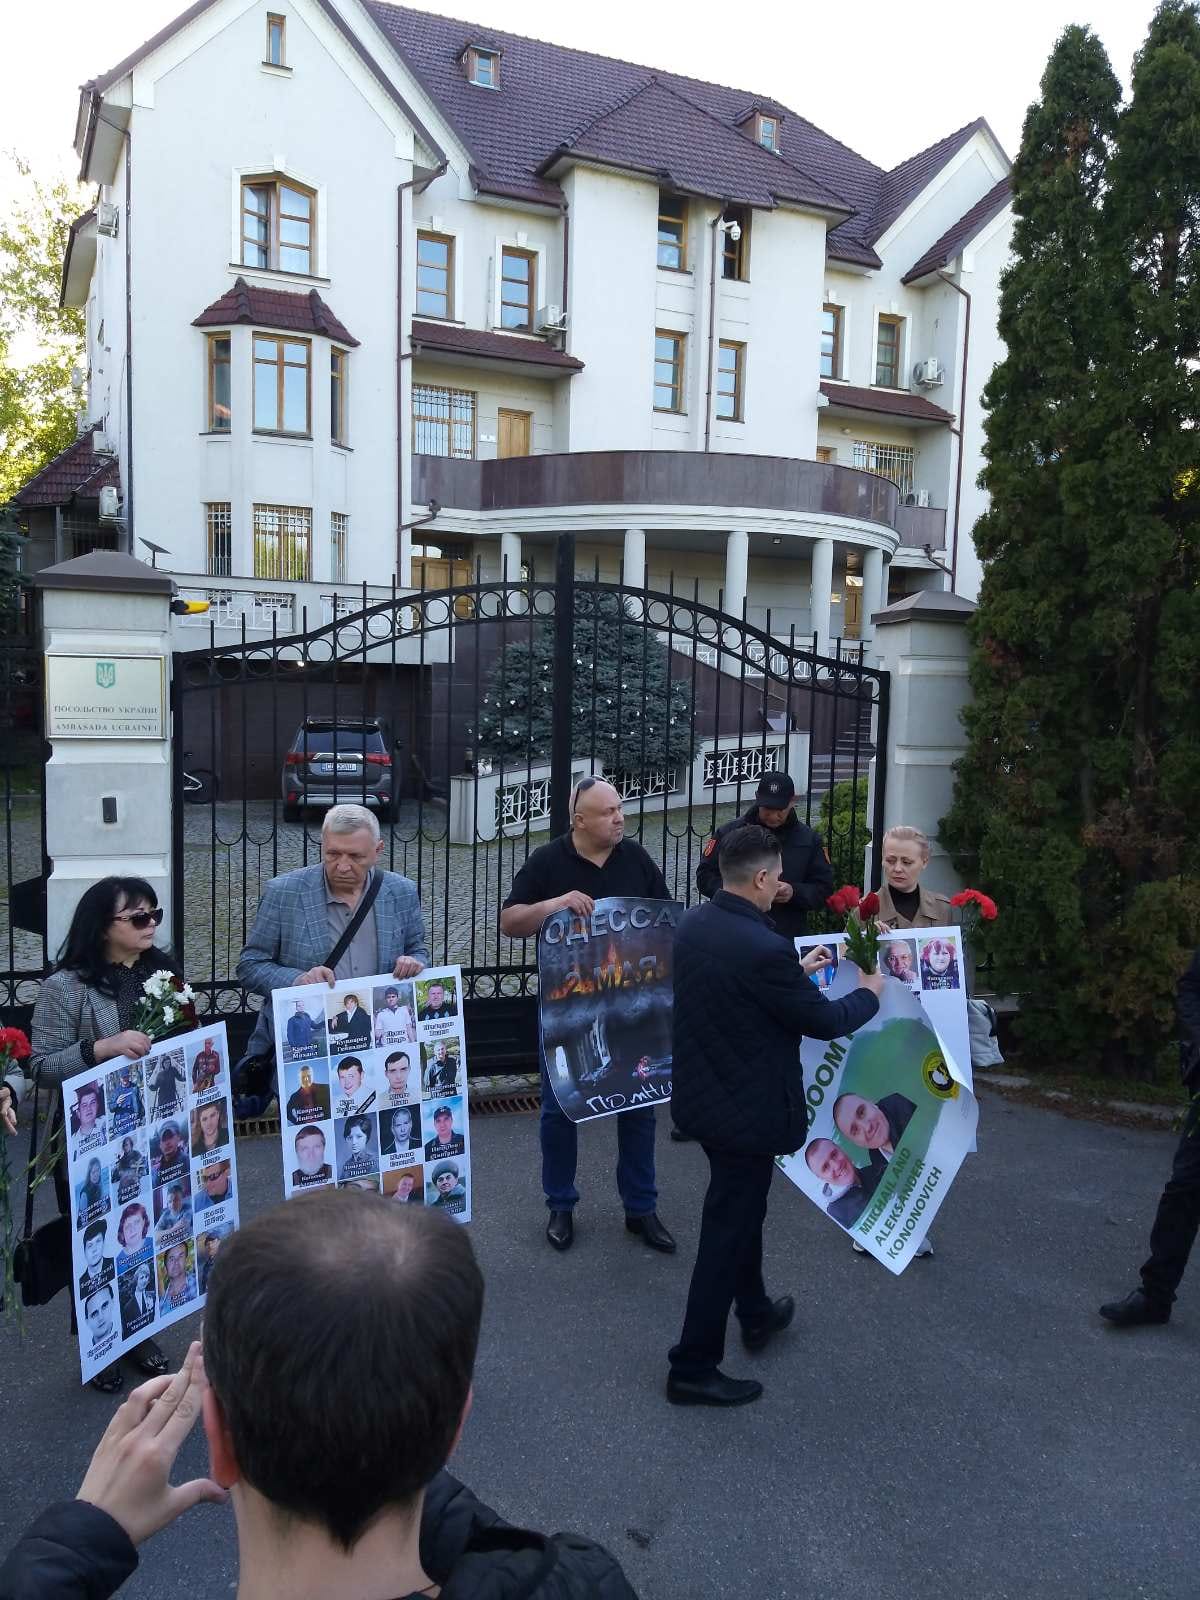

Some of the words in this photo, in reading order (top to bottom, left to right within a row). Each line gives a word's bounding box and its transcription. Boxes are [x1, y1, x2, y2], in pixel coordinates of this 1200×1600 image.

[54, 704, 115, 714] ПОСОЛЬСТВО
[118, 705, 158, 715] УКРАЇНИ
[56, 723, 108, 732] AMBASADA
[111, 724, 157, 733] UCRAINEI
[545, 905, 676, 946] ОДЕССА
[892, 1147, 911, 1179] AND
[874, 1158, 926, 1247] ALEKSANDER
[886, 1166, 942, 1260] KONONOVICH
